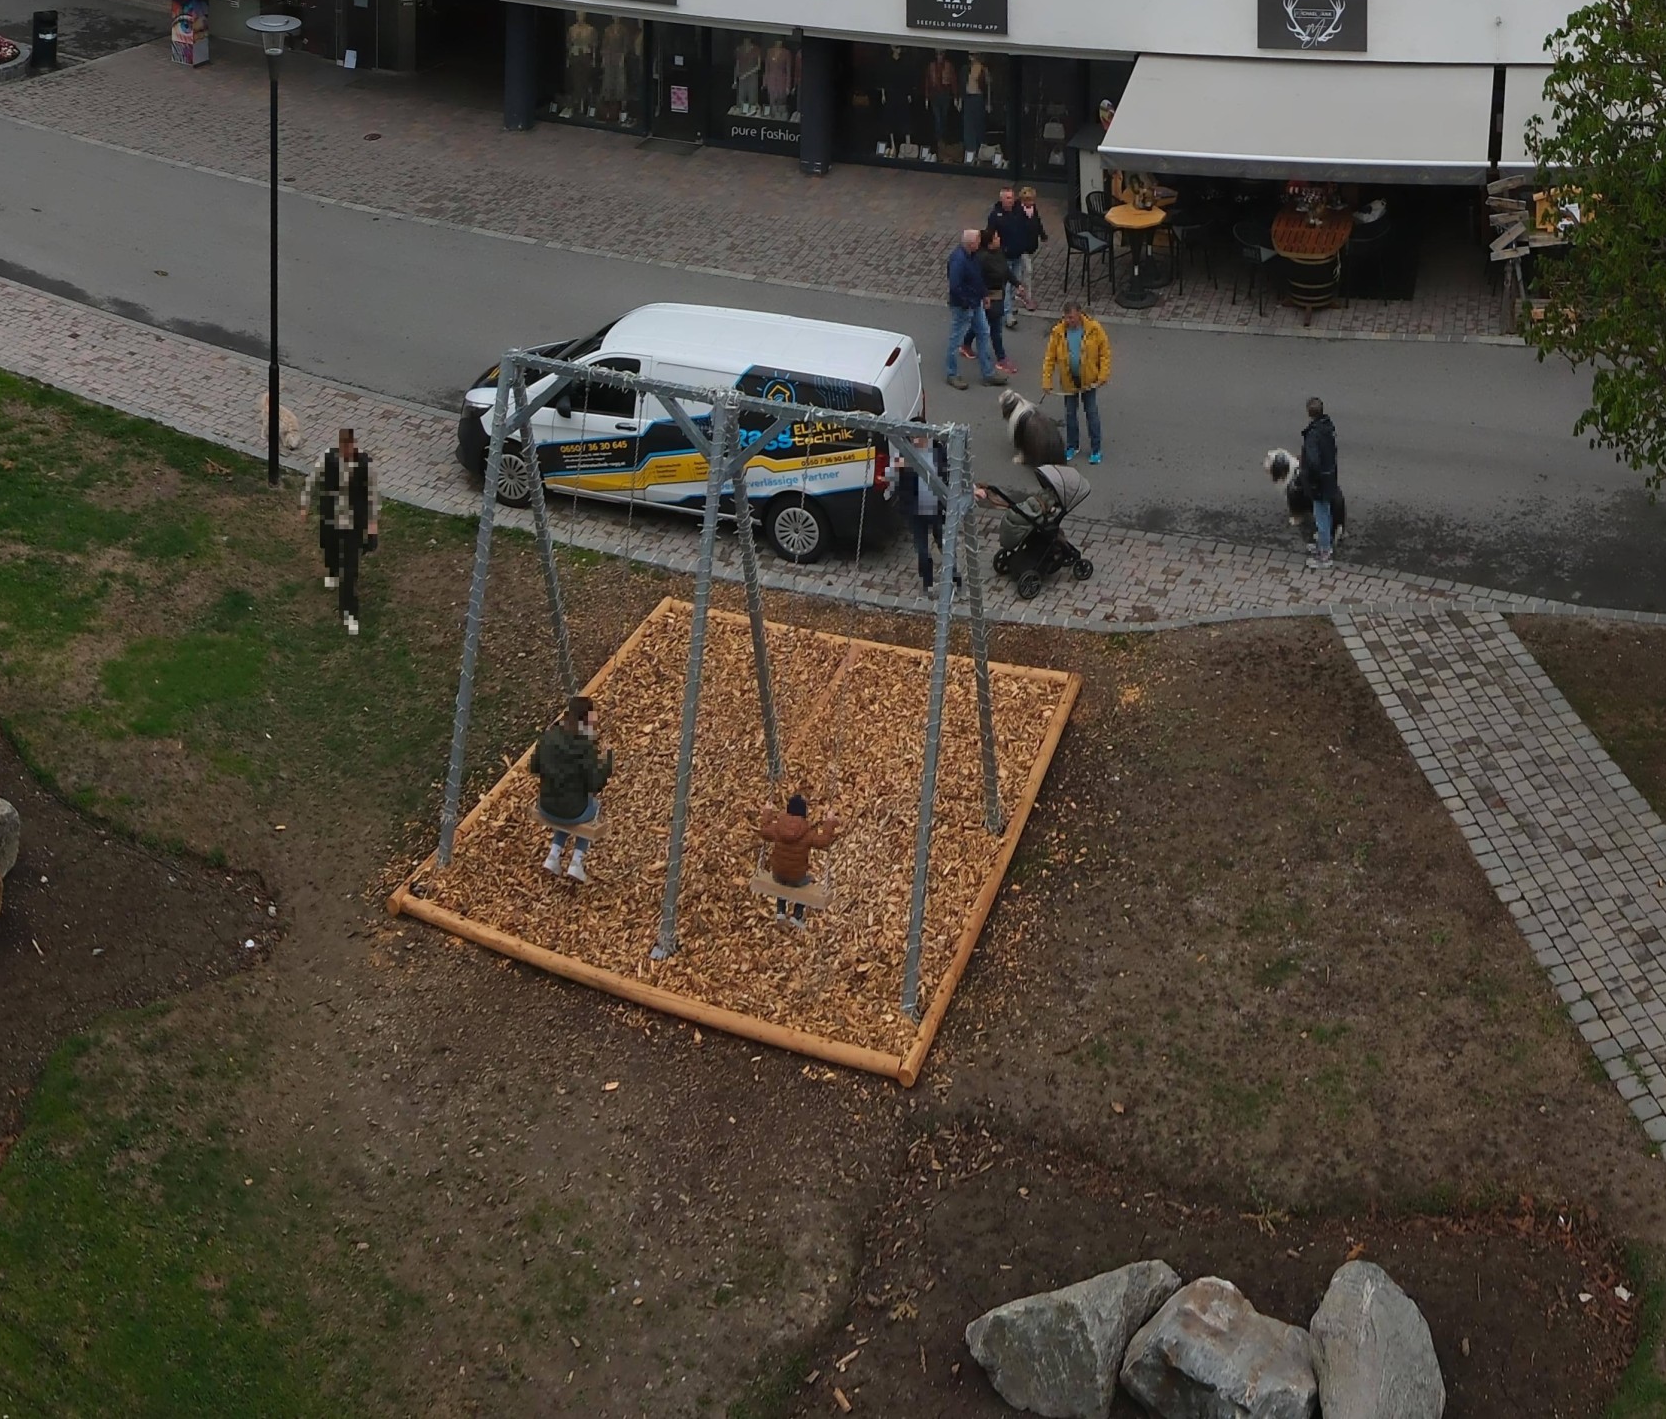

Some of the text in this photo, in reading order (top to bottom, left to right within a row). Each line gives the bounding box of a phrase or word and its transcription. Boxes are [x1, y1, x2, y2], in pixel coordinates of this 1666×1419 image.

[943, 3, 972, 11] SEEFELD
[916, 19, 946, 27] SEEFELD
[948, 21, 982, 30] SHOPPING
[731, 126, 757, 137] pure
[599, 442, 611, 450] 30
[612, 440, 628, 449] 645
[802, 470, 840, 482] Partner
